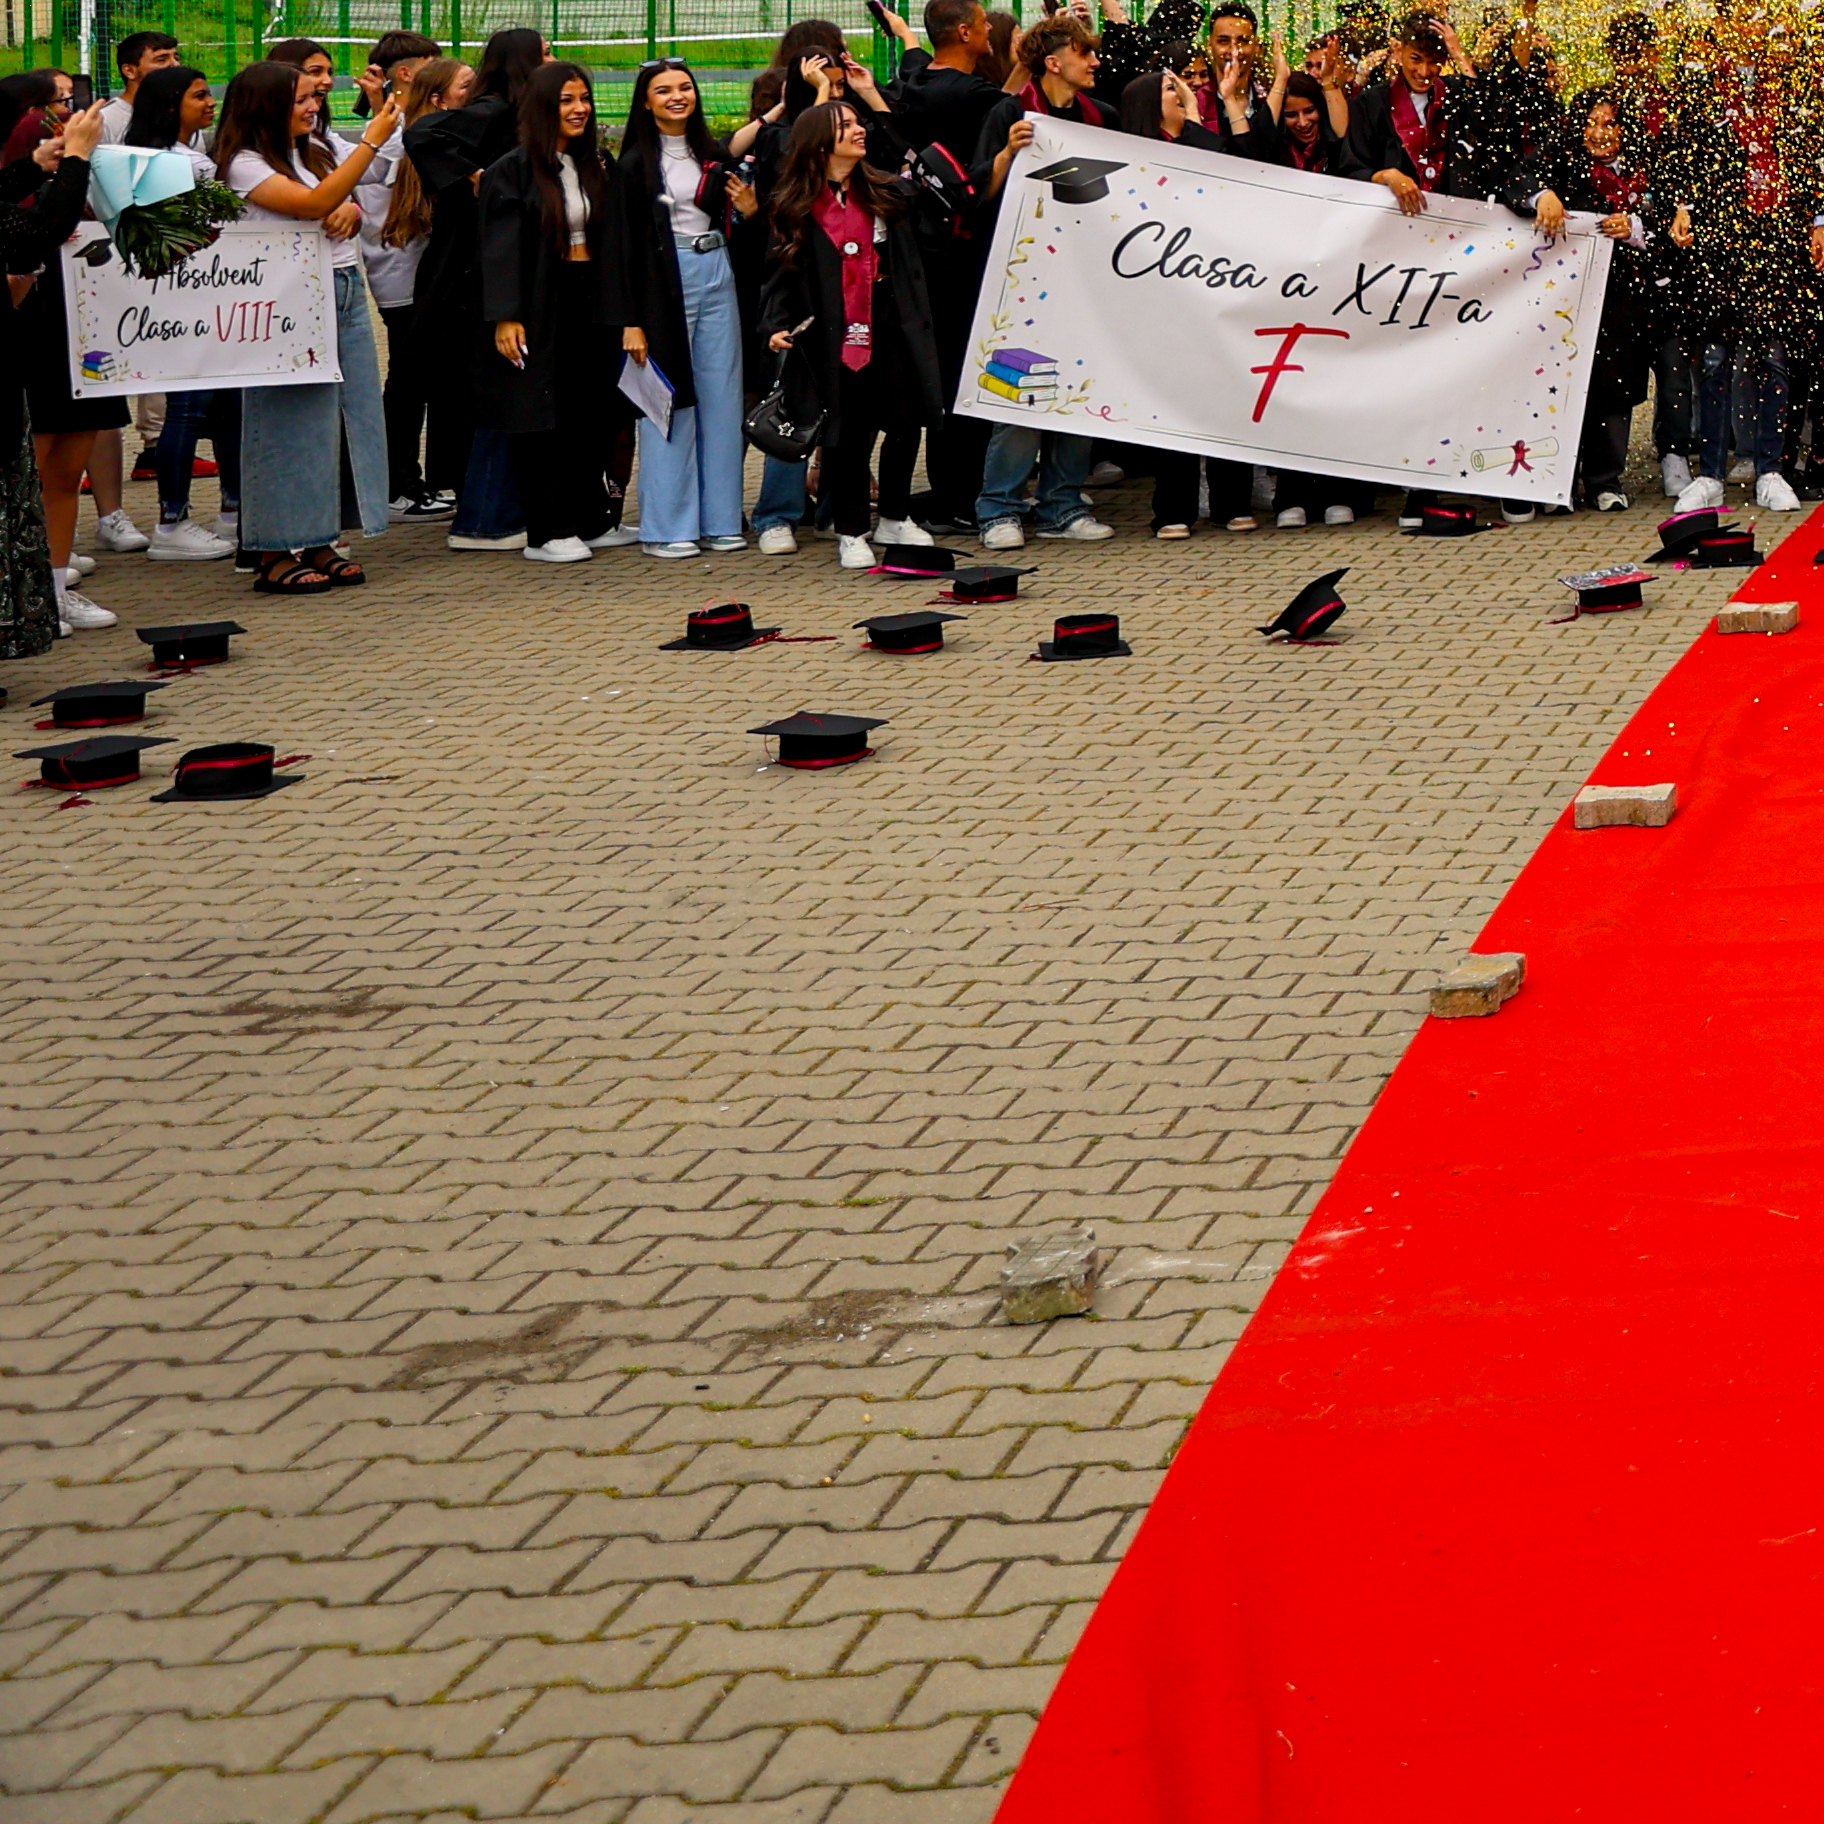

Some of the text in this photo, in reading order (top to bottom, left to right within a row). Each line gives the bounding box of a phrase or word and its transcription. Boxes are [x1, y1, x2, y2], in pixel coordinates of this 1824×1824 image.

[1111, 221, 1494, 330] Clasa a XII-a
[117, 305, 189, 348] Clasa
[194, 320, 211, 338] a
[1250, 323, 1351, 424] F
